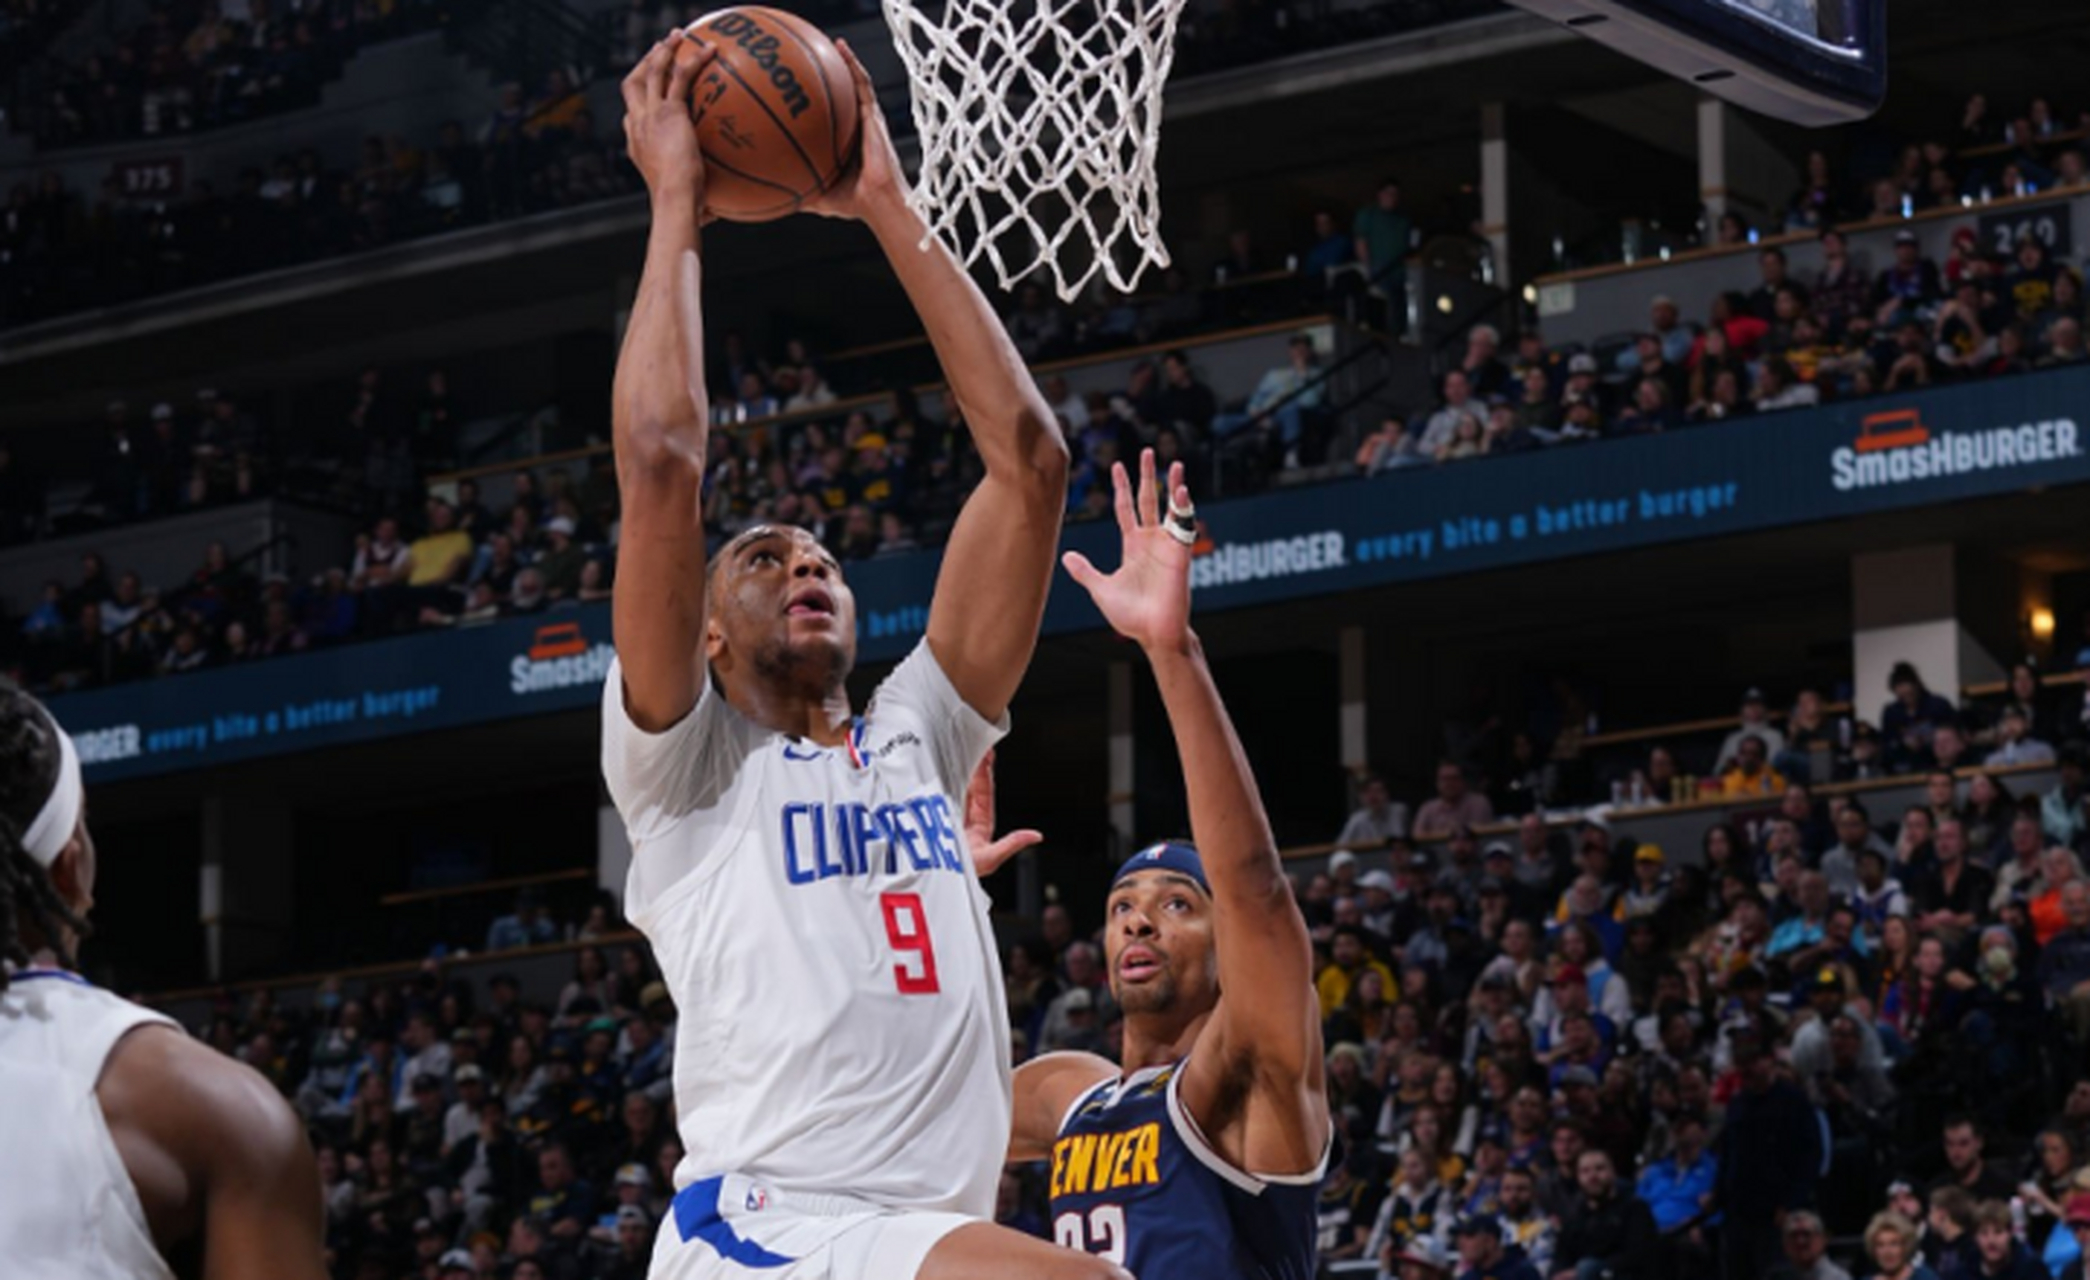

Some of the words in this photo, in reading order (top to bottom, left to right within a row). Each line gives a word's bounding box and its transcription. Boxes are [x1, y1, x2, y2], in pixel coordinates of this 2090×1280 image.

[709, 12, 811, 120] Wilson
[1356, 529, 1432, 560] every
[1442, 517, 1499, 550] bite
[1510, 514, 1528, 539] a
[1536, 499, 1629, 535] better
[1639, 482, 1737, 519] burger
[867, 605, 929, 637] bett
[148, 724, 207, 752] every
[214, 713, 258, 742] bite
[285, 699, 356, 730] better
[363, 685, 440, 718] burger
[780, 794, 965, 886] CLIPPERS
[879, 892, 941, 995] 9
[1050, 1121, 1161, 1200] ENVER
